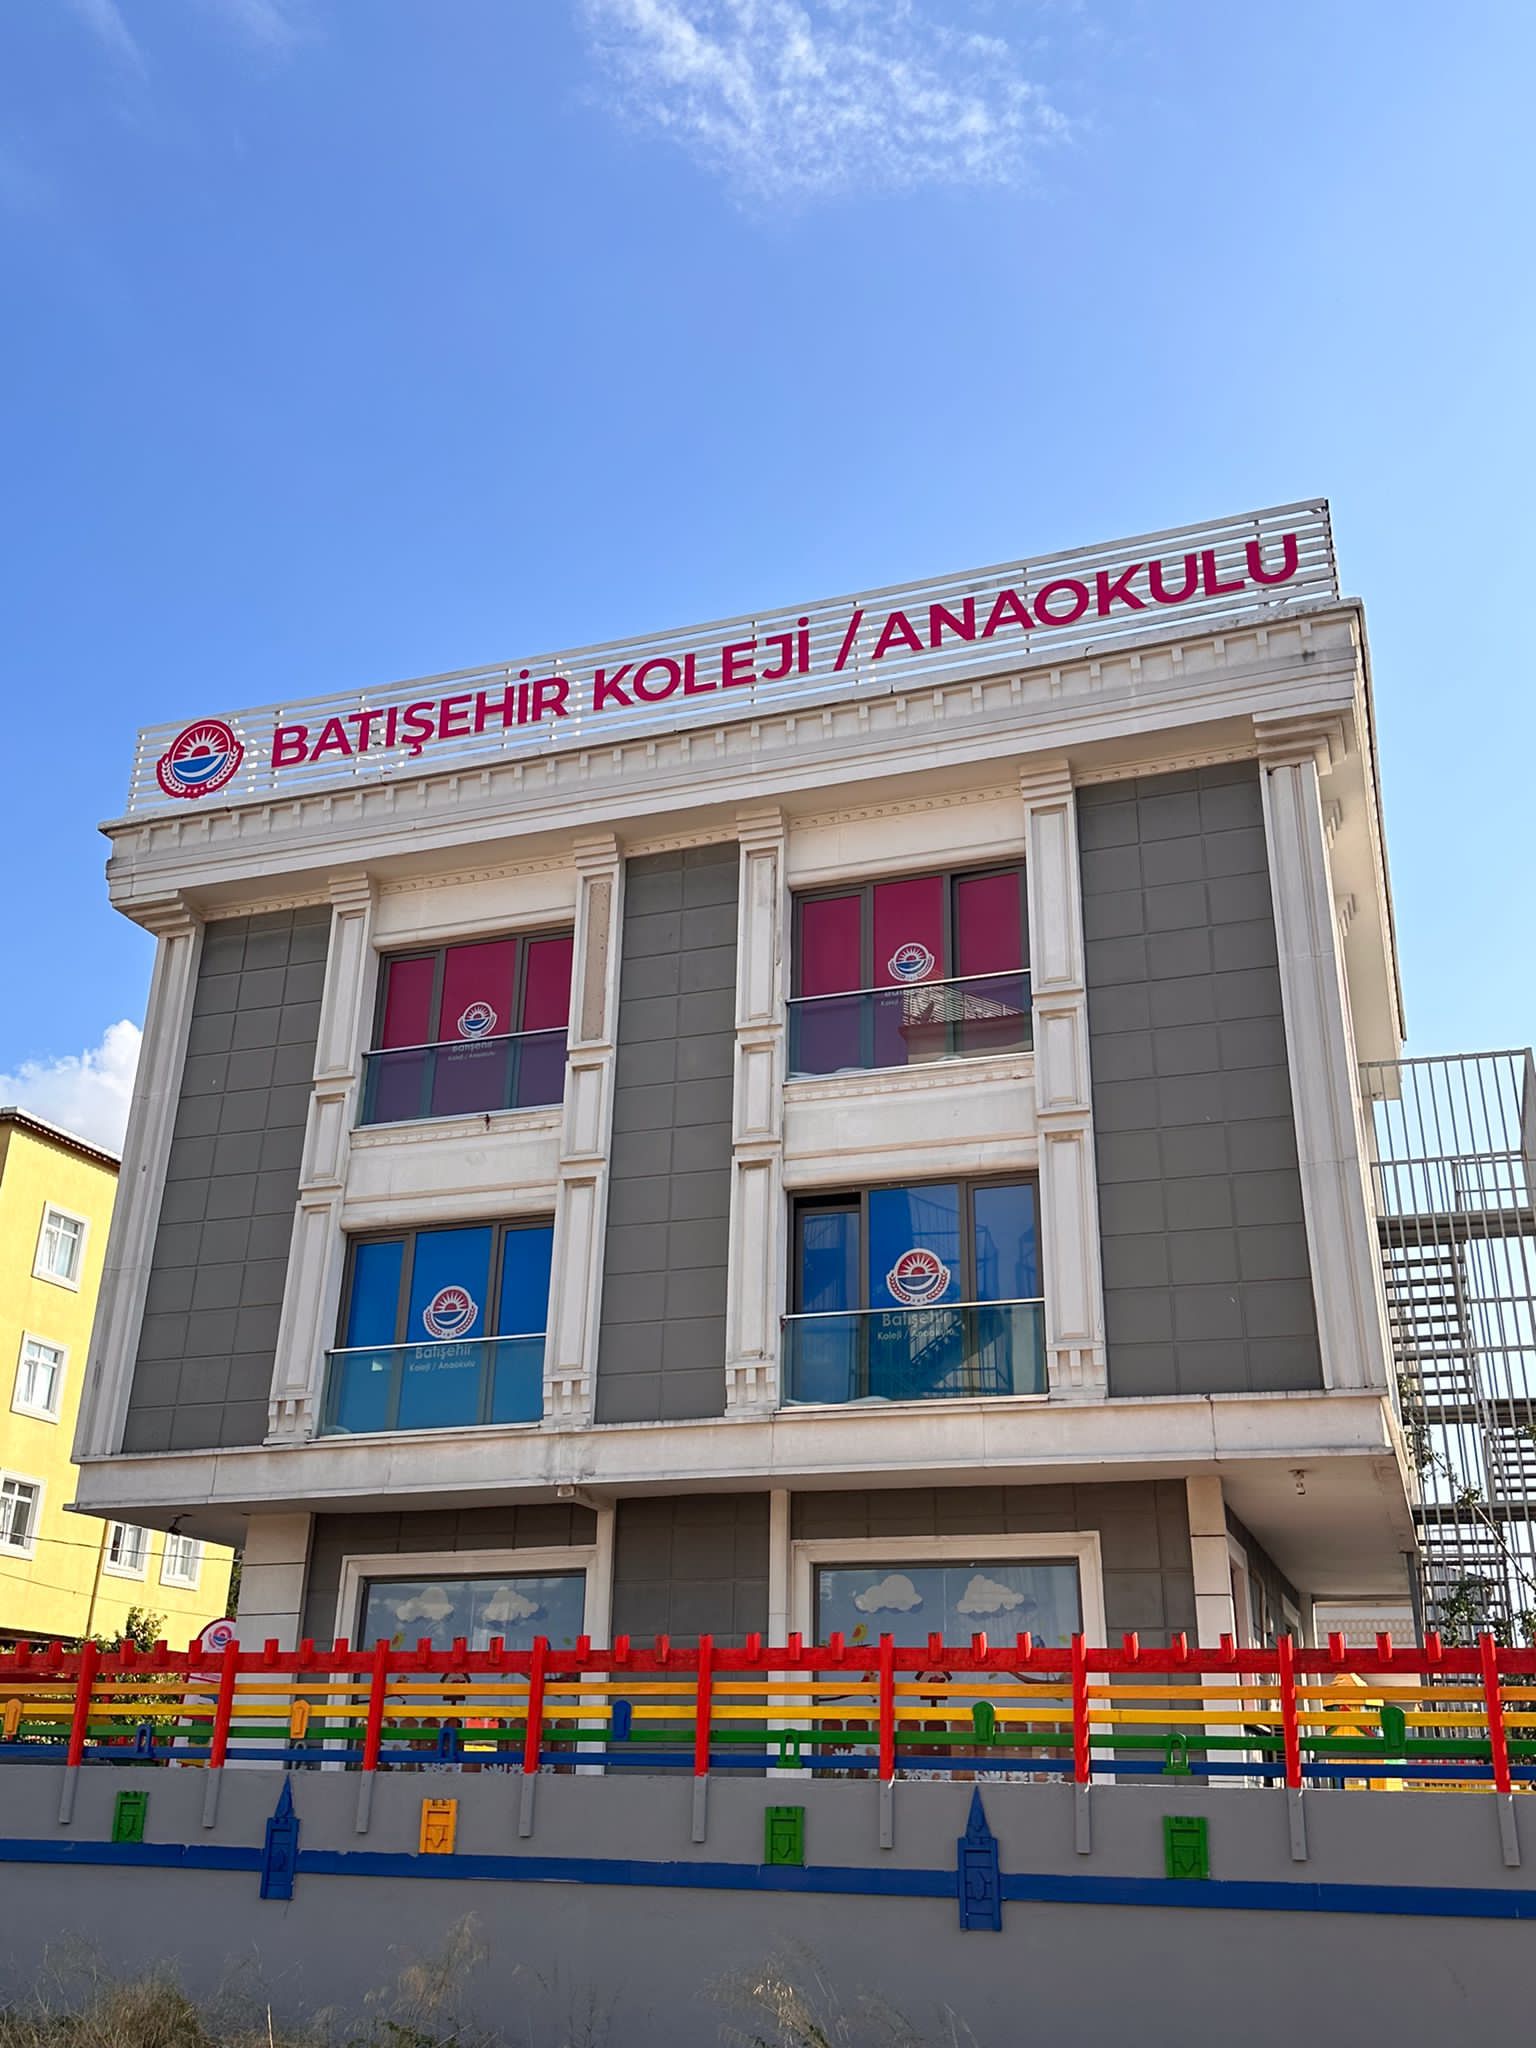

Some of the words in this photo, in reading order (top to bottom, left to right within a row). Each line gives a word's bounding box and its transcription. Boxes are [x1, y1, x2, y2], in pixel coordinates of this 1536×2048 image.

[271, 668, 571, 768] BATIŞEHİR
[593, 617, 811, 711] KOLEJİ
[871, 533, 1300, 660] ANAOKULU
